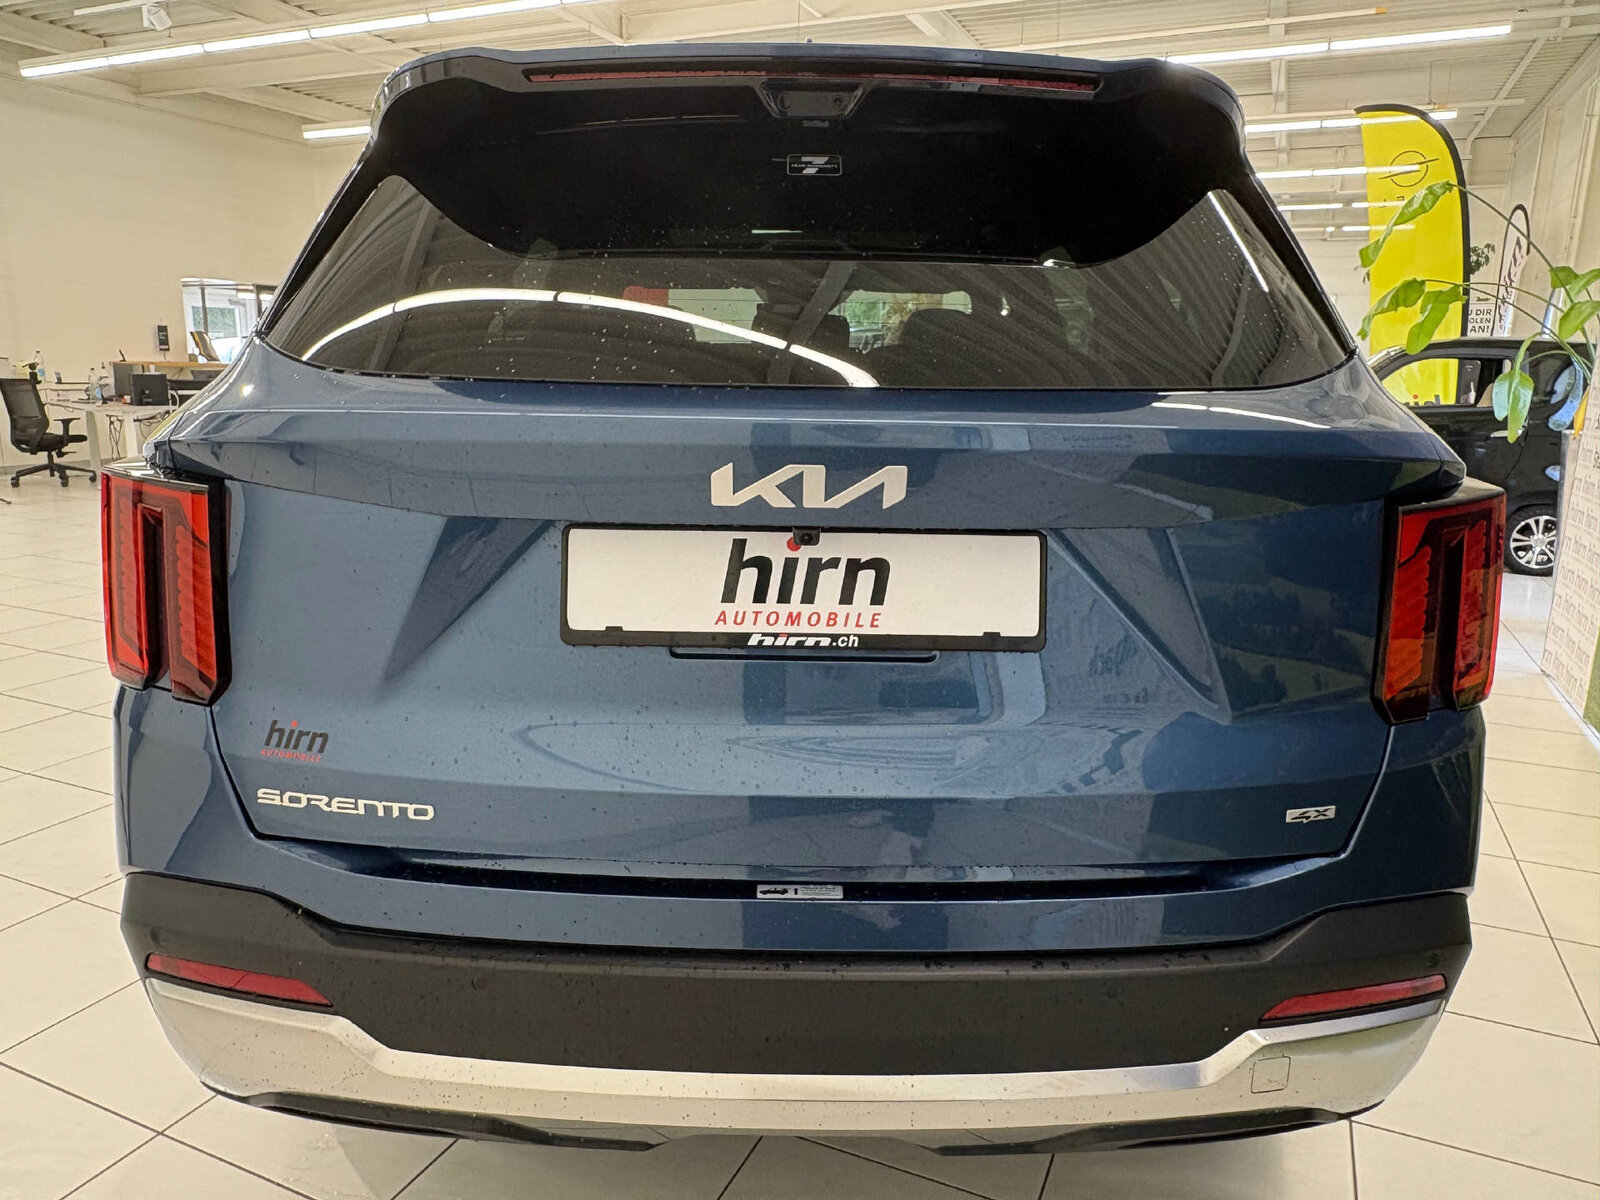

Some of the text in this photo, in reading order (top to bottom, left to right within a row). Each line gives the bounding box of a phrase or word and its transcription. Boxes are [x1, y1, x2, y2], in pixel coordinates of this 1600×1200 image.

[711, 462, 908, 509] KIA
[720, 538, 891, 606] hirn
[714, 610, 882, 628] AUTOMOBILE
[747, 633, 859, 648] hirn.ch
[264, 719, 329, 753] hirn
[257, 788, 435, 821] SORENTO
